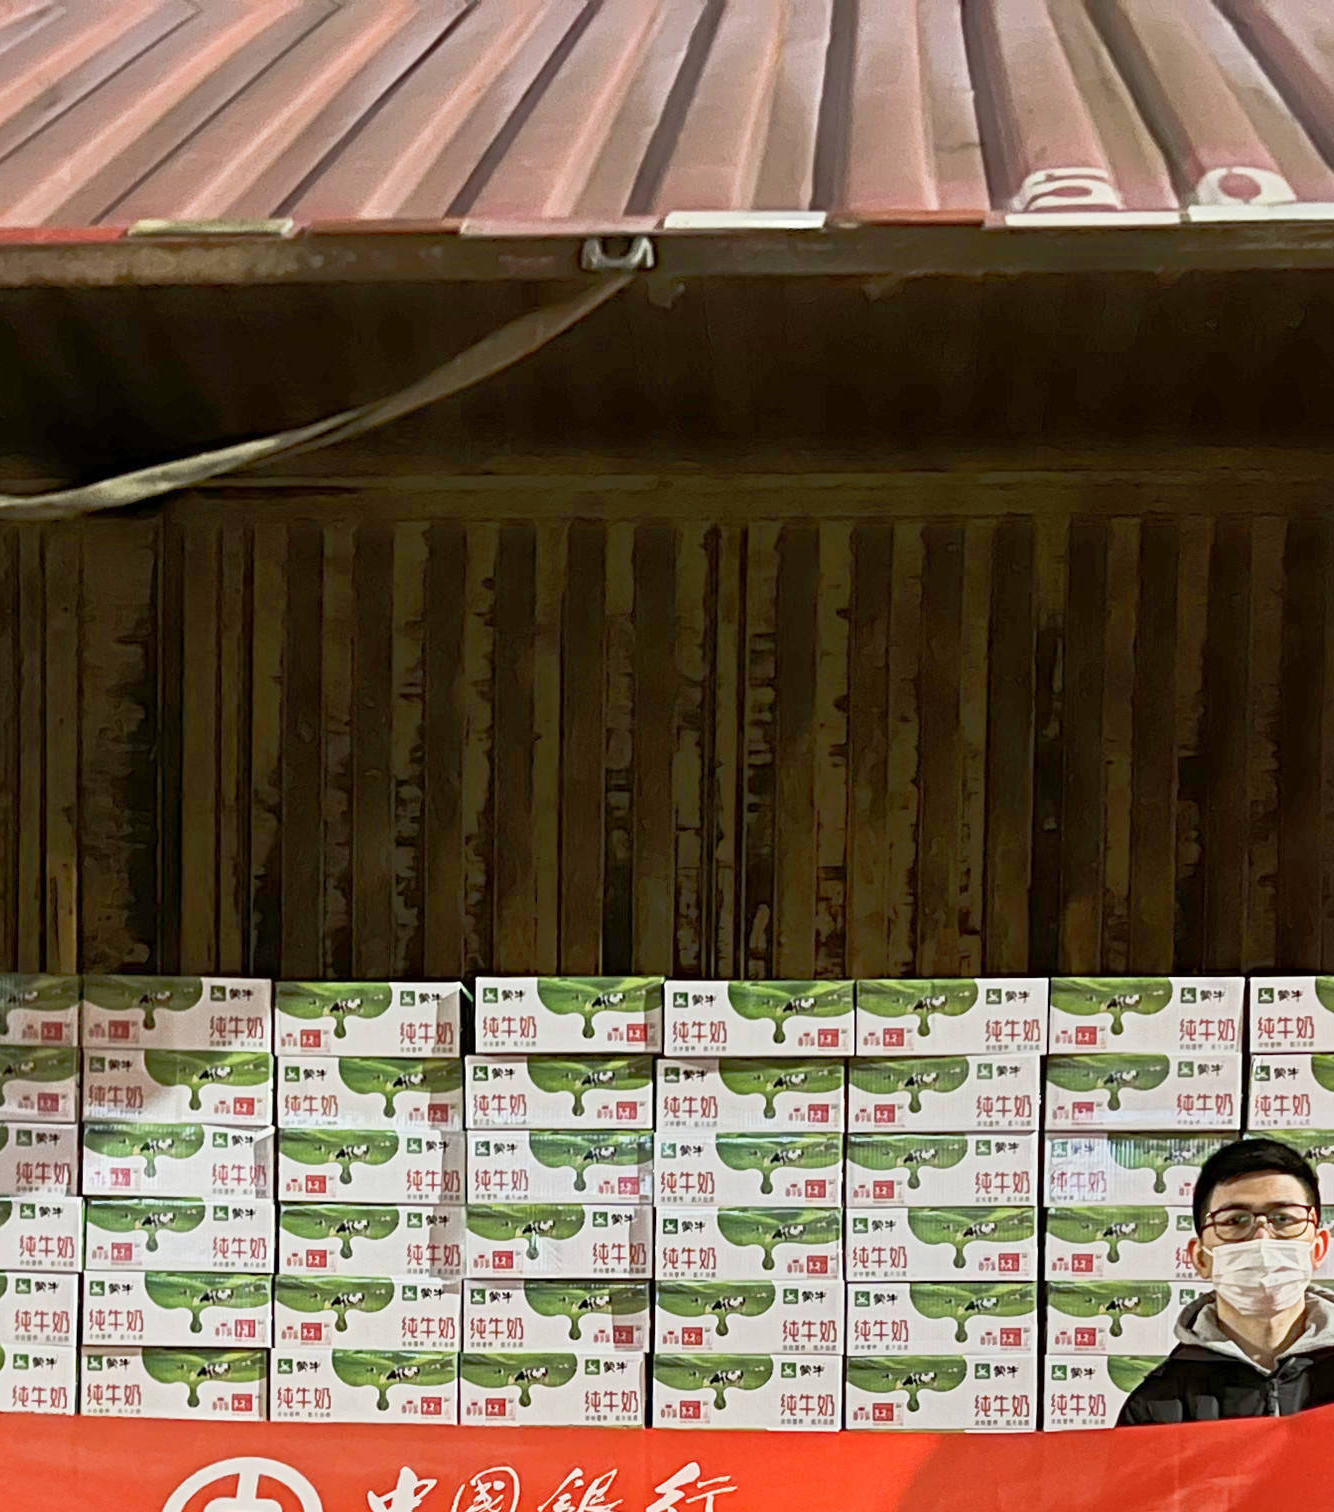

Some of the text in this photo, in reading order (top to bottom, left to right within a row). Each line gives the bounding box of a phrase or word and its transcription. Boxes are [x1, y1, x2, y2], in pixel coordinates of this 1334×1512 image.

[210, 1015, 265, 1040] 纯牛奶
[401, 1023, 454, 1046] 纯牛奶
[483, 1015, 537, 1038] 纯牛奶
[674, 1020, 728, 1044] 纯牛奶
[986, 1018, 1041, 1042] 纯牛奶
[1180, 1018, 1236, 1042] 纯牛奶
[1258, 1015, 1316, 1040] 纯牛奶
[285, 1095, 339, 1115] 纯牛奶
[474, 1093, 527, 1113] 纯牛奶
[663, 1095, 718, 1117] 纯牛奶
[976, 1095, 1032, 1118] 纯牛奶
[1177, 1093, 1234, 1114] 纯牛奶
[1255, 1093, 1311, 1116] 纯牛奶
[16, 1161, 71, 1185] 纯牛奶
[212, 1164, 267, 1185] 纯牛奶
[406, 1169, 460, 1193] 纯牛奶
[474, 1169, 529, 1192] 纯牛奶
[661, 1172, 714, 1193] 纯牛奶
[976, 1170, 1030, 1193] 纯牛奶
[19, 1235, 75, 1259] 纯牛奶
[213, 1236, 267, 1259] 纯牛奶
[407, 1242, 460, 1267] 纯牛奶
[593, 1243, 646, 1265] 纯牛奶
[664, 1247, 716, 1269] 纯牛奶
[853, 1245, 908, 1269] 纯牛奶
[15, 1311, 70, 1333] 纯牛奶
[90, 1309, 145, 1332] 纯牛奶
[402, 1317, 456, 1340] 纯牛奶
[470, 1317, 524, 1341] 纯牛奶
[783, 1319, 837, 1343] 纯牛奶
[857, 1319, 909, 1342] 纯牛奶
[12, 1386, 68, 1407] 纯牛奶
[87, 1383, 142, 1406] 纯牛奶
[278, 1387, 332, 1409] 纯牛奶
[585, 1390, 637, 1412] 纯牛奶
[781, 1393, 835, 1417] 纯牛奶
[976, 1394, 1030, 1417] 纯牛奶
[1051, 1393, 1107, 1417] 纯牛奶
